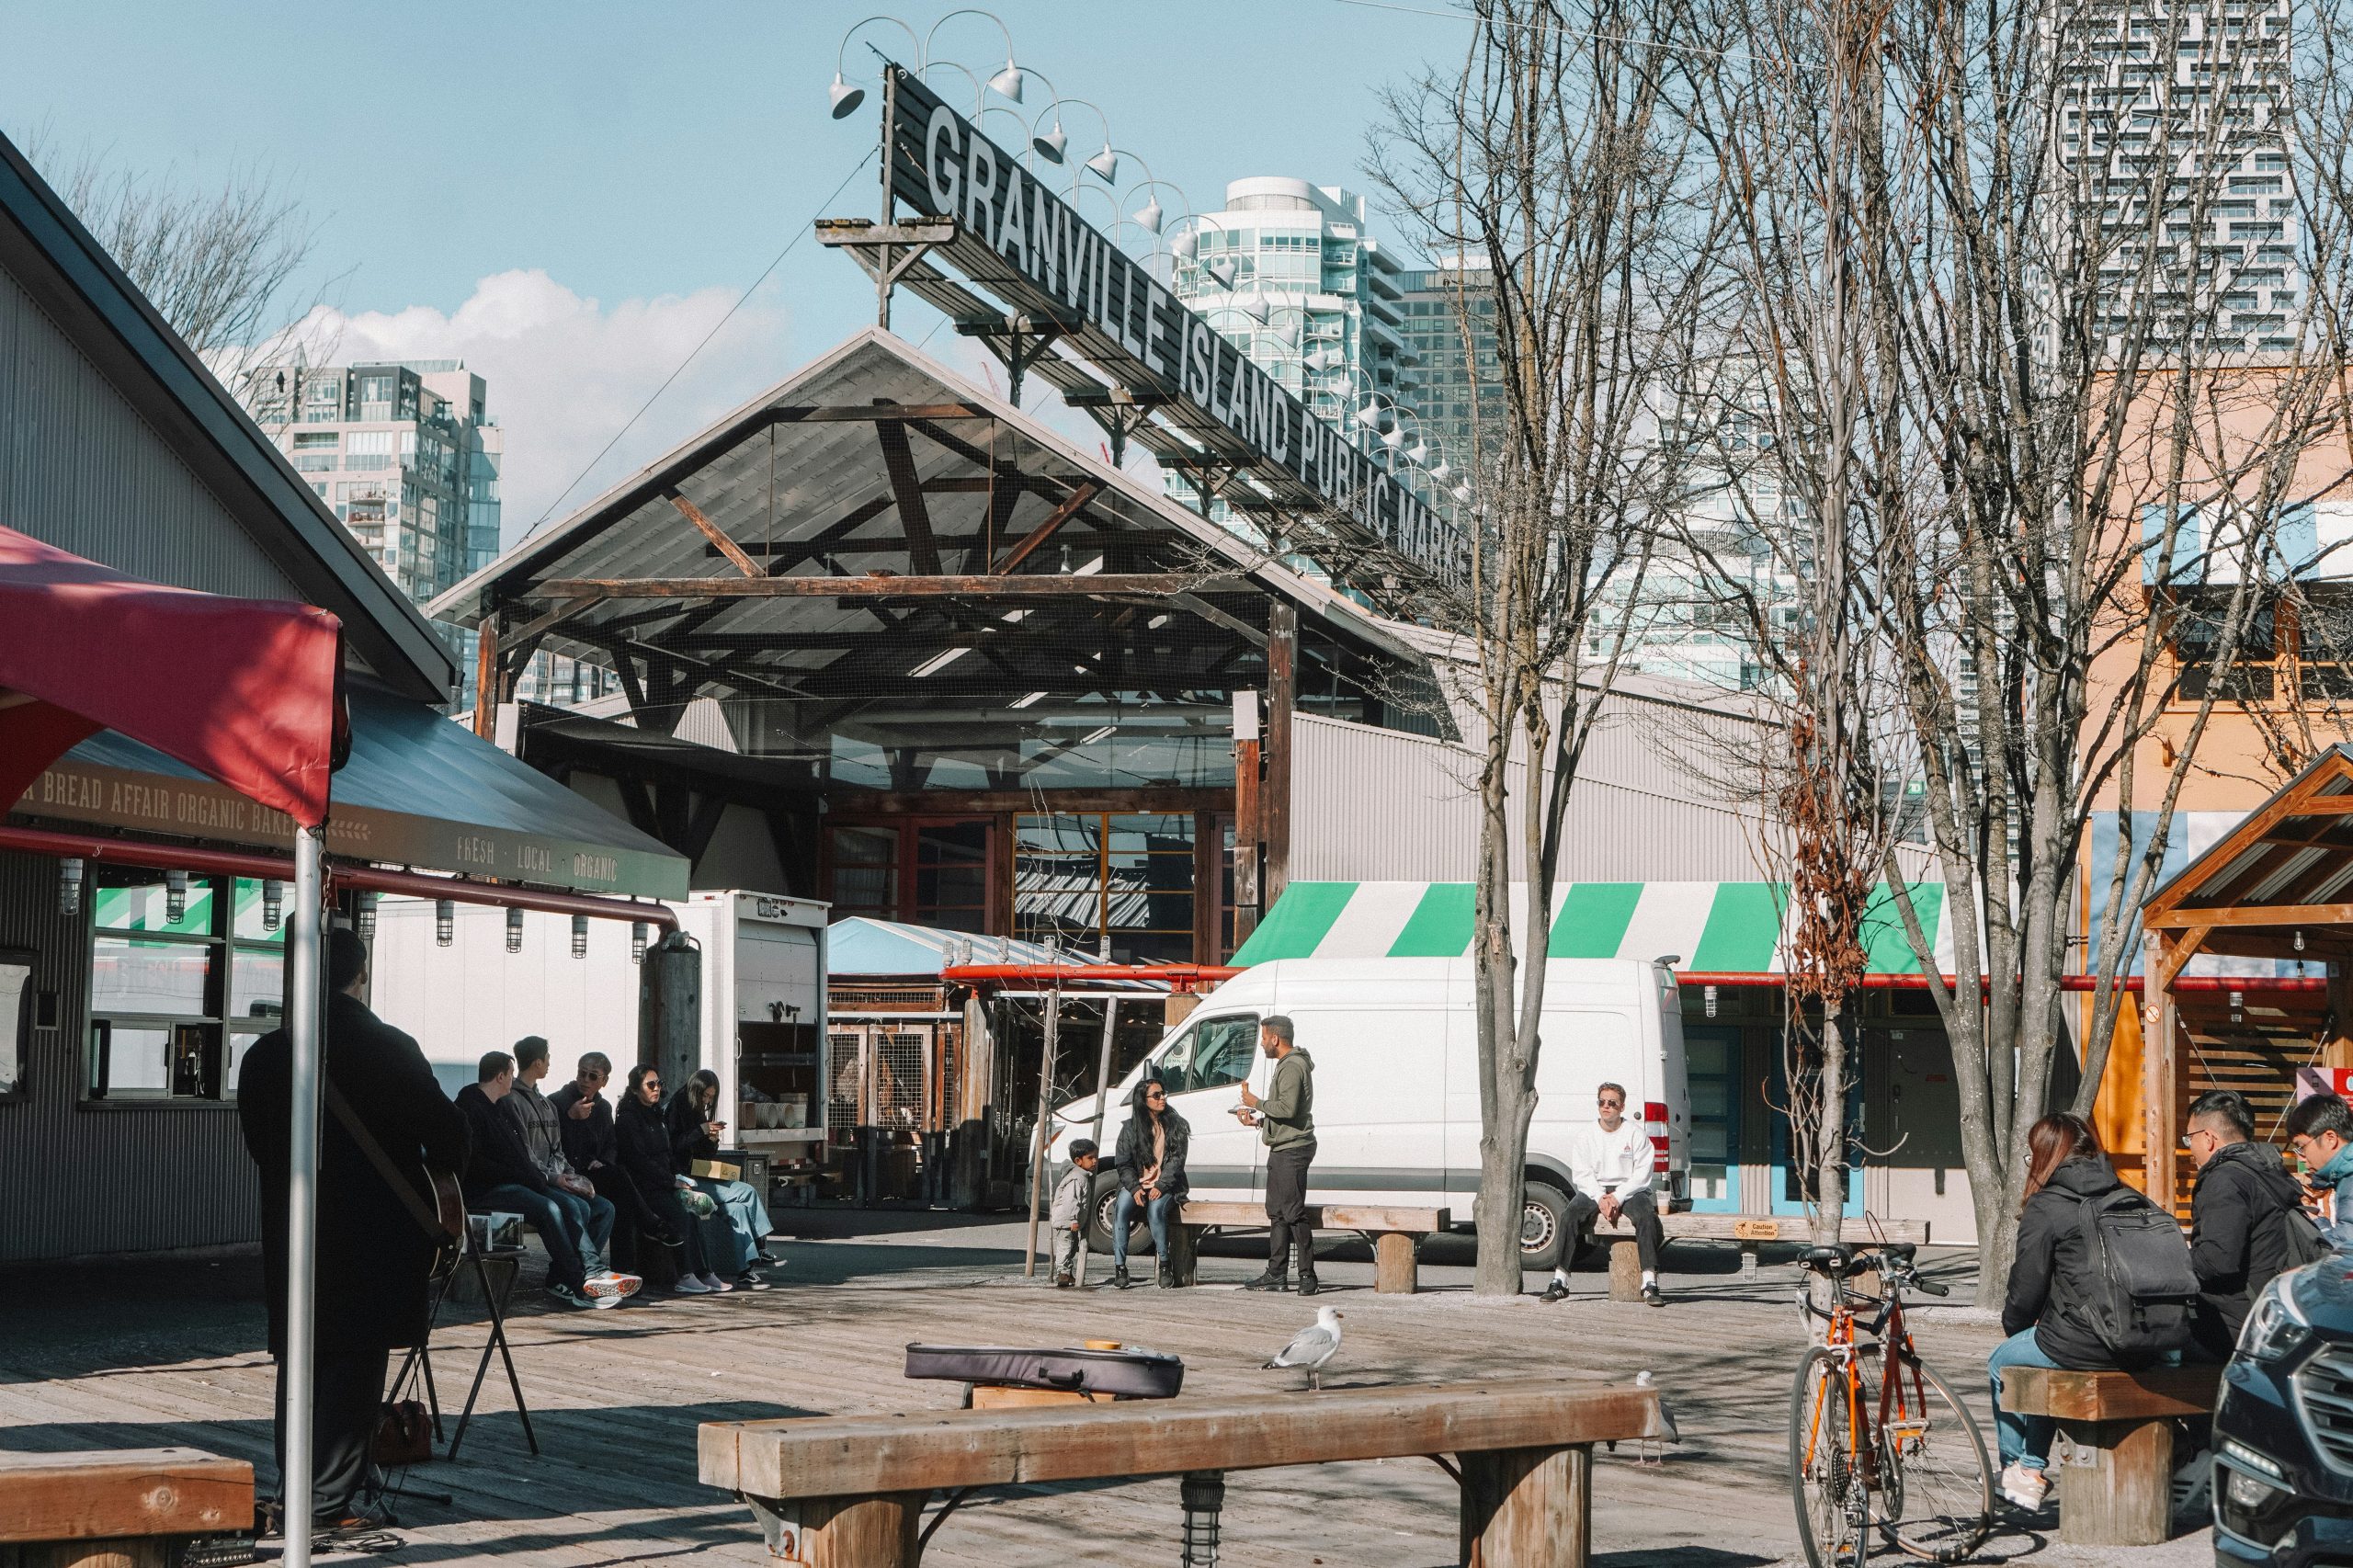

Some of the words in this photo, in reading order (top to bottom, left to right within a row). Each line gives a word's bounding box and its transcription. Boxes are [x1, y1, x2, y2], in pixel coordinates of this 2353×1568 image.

[926, 105, 1167, 376] GRANVILLE
[1179, 310, 1288, 464] ISLAND
[1301, 415, 1390, 538] PUBLIC
[1398, 487, 1472, 588] MARKE
[43, 771, 102, 810] BREAD
[111, 782, 169, 820] AFFAIR
[177, 792, 245, 830] ORGANIC
[457, 836, 494, 865] FRESH
[517, 845, 551, 872] LOCAL
[574, 853, 618, 882] ORGANIC
